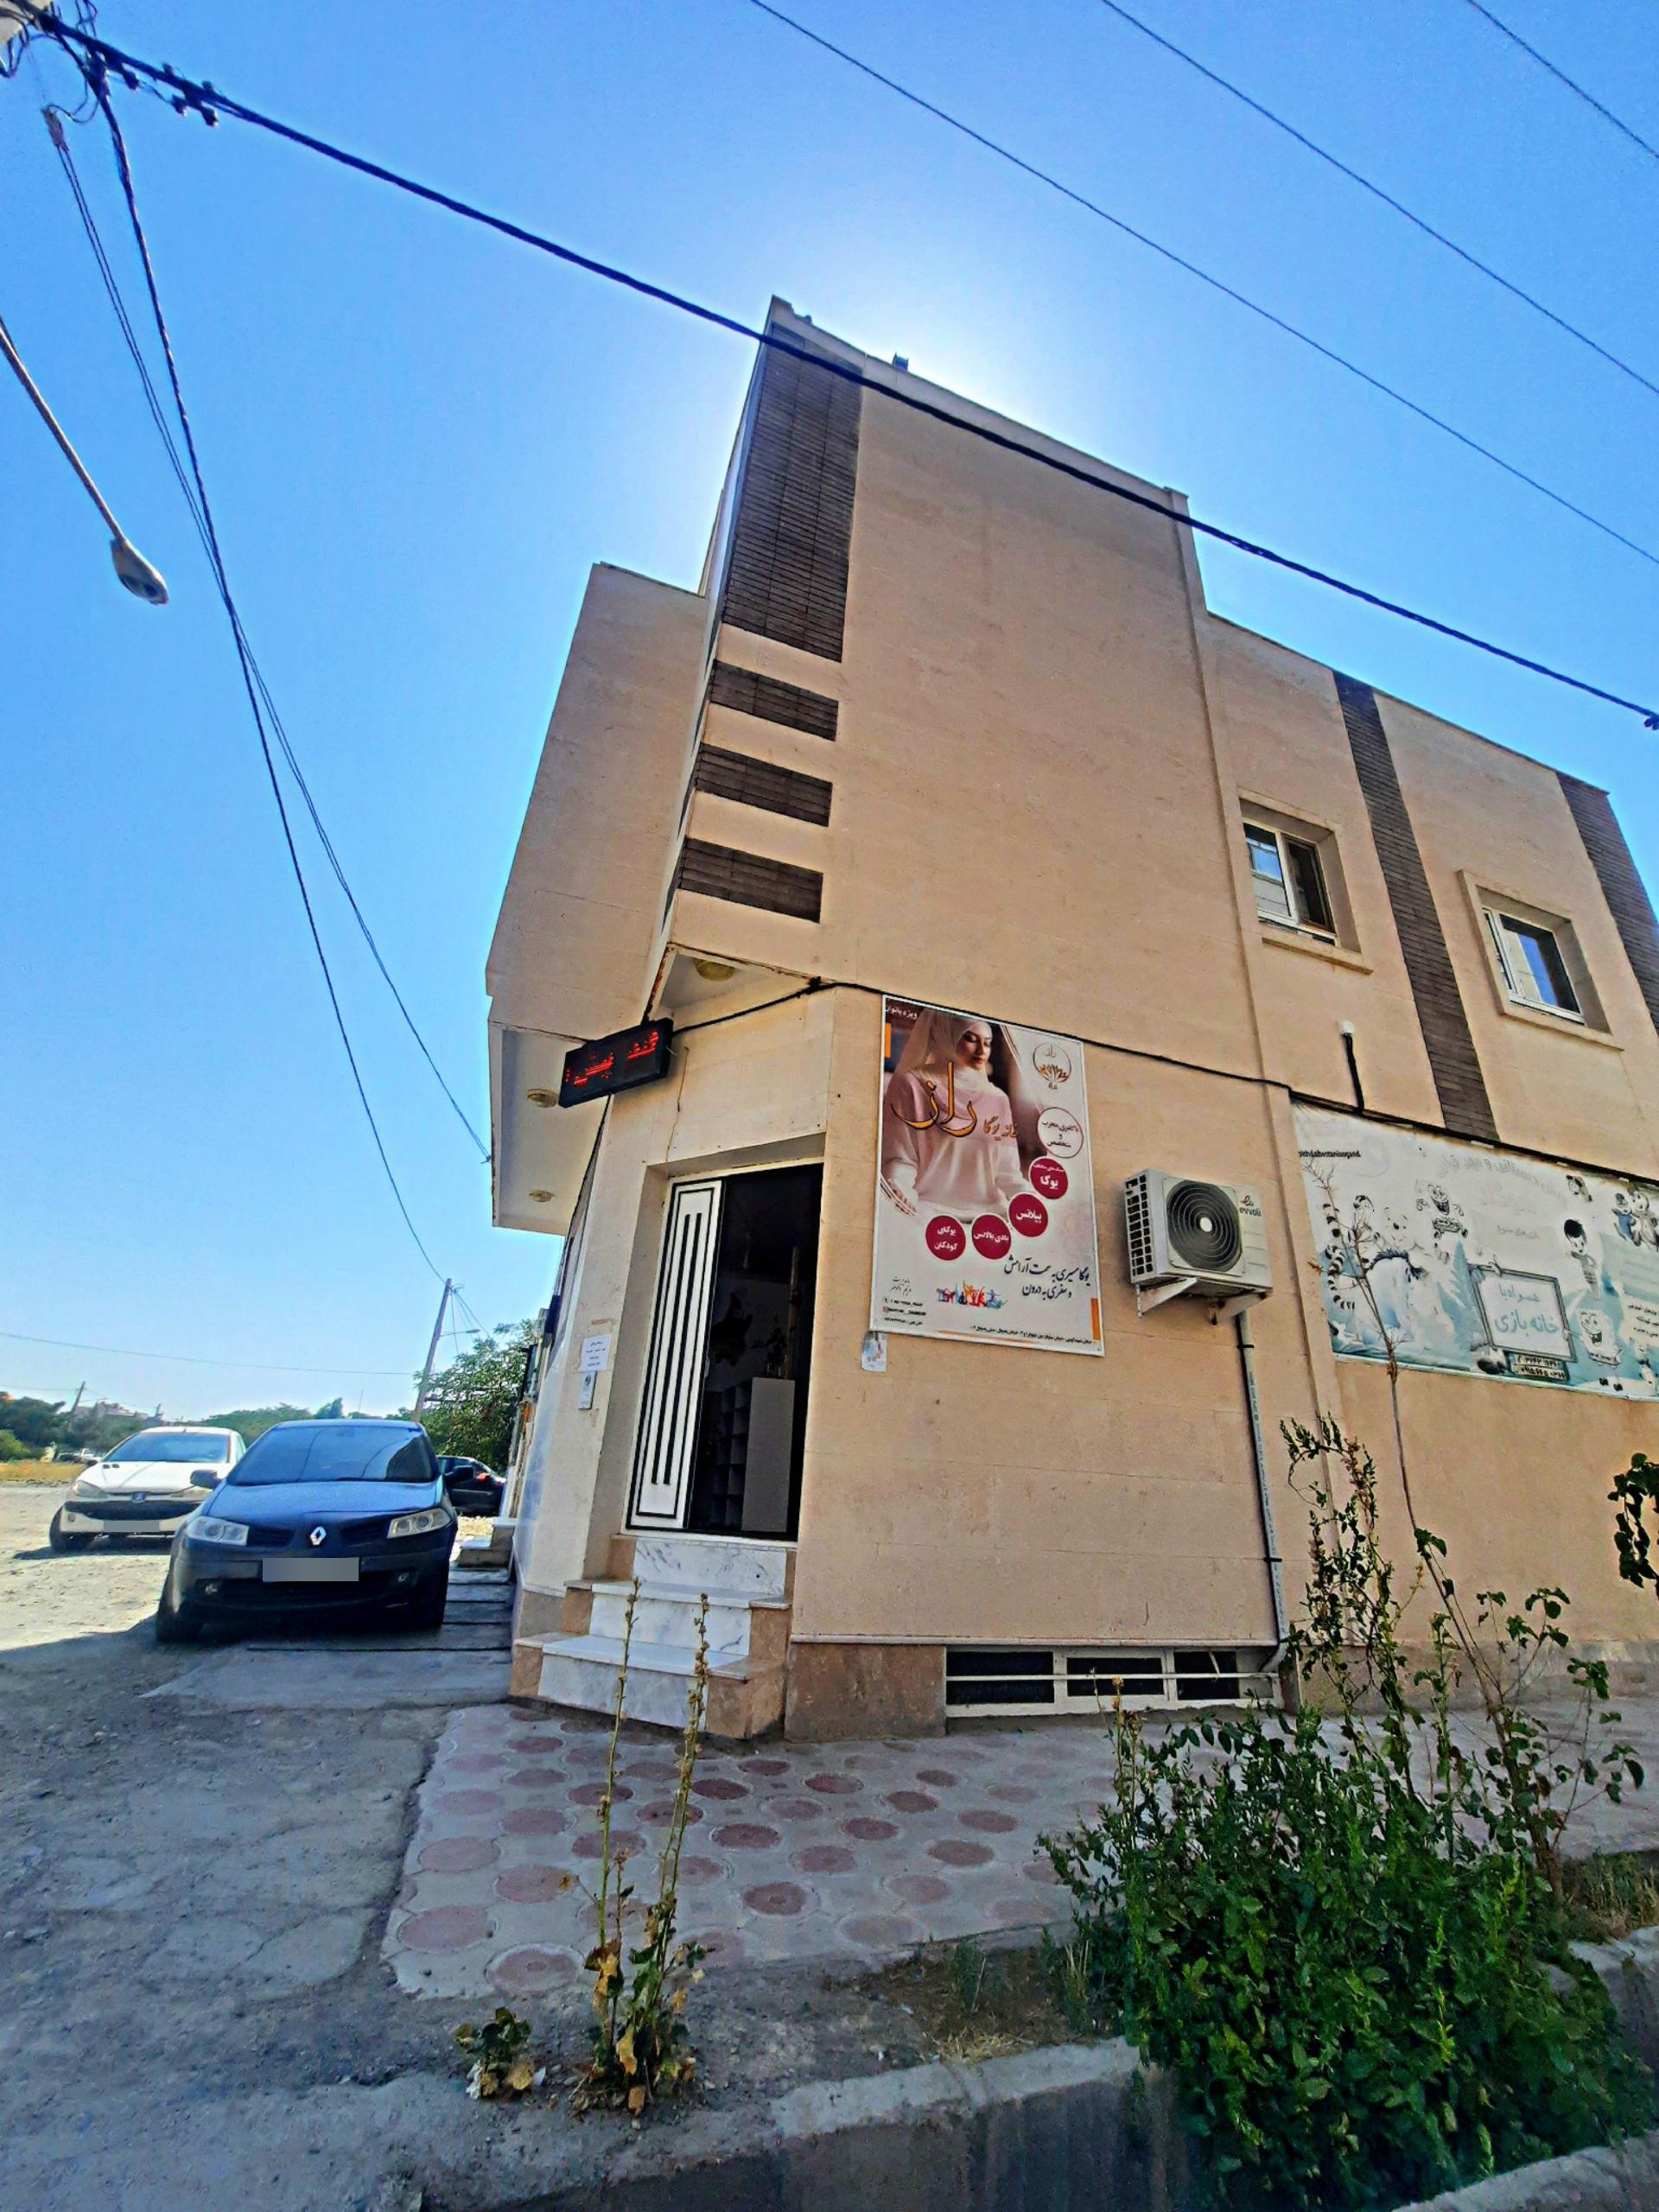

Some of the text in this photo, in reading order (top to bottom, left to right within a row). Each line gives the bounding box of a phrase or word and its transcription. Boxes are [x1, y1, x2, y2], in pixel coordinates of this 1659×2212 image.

[891, 1060, 977, 1137] راز
[983, 1116, 1001, 1141] یوگا
[1039, 1175, 1058, 1190] یوگا
[1015, 1210, 1042, 1224] پیلاتس
[937, 1226, 956, 1236] یوگای
[974, 1230, 1009, 1243] بادی بالانس
[934, 1241, 958, 1251] کودکان
[1494, 1308, 1560, 1338] خانه بازی
